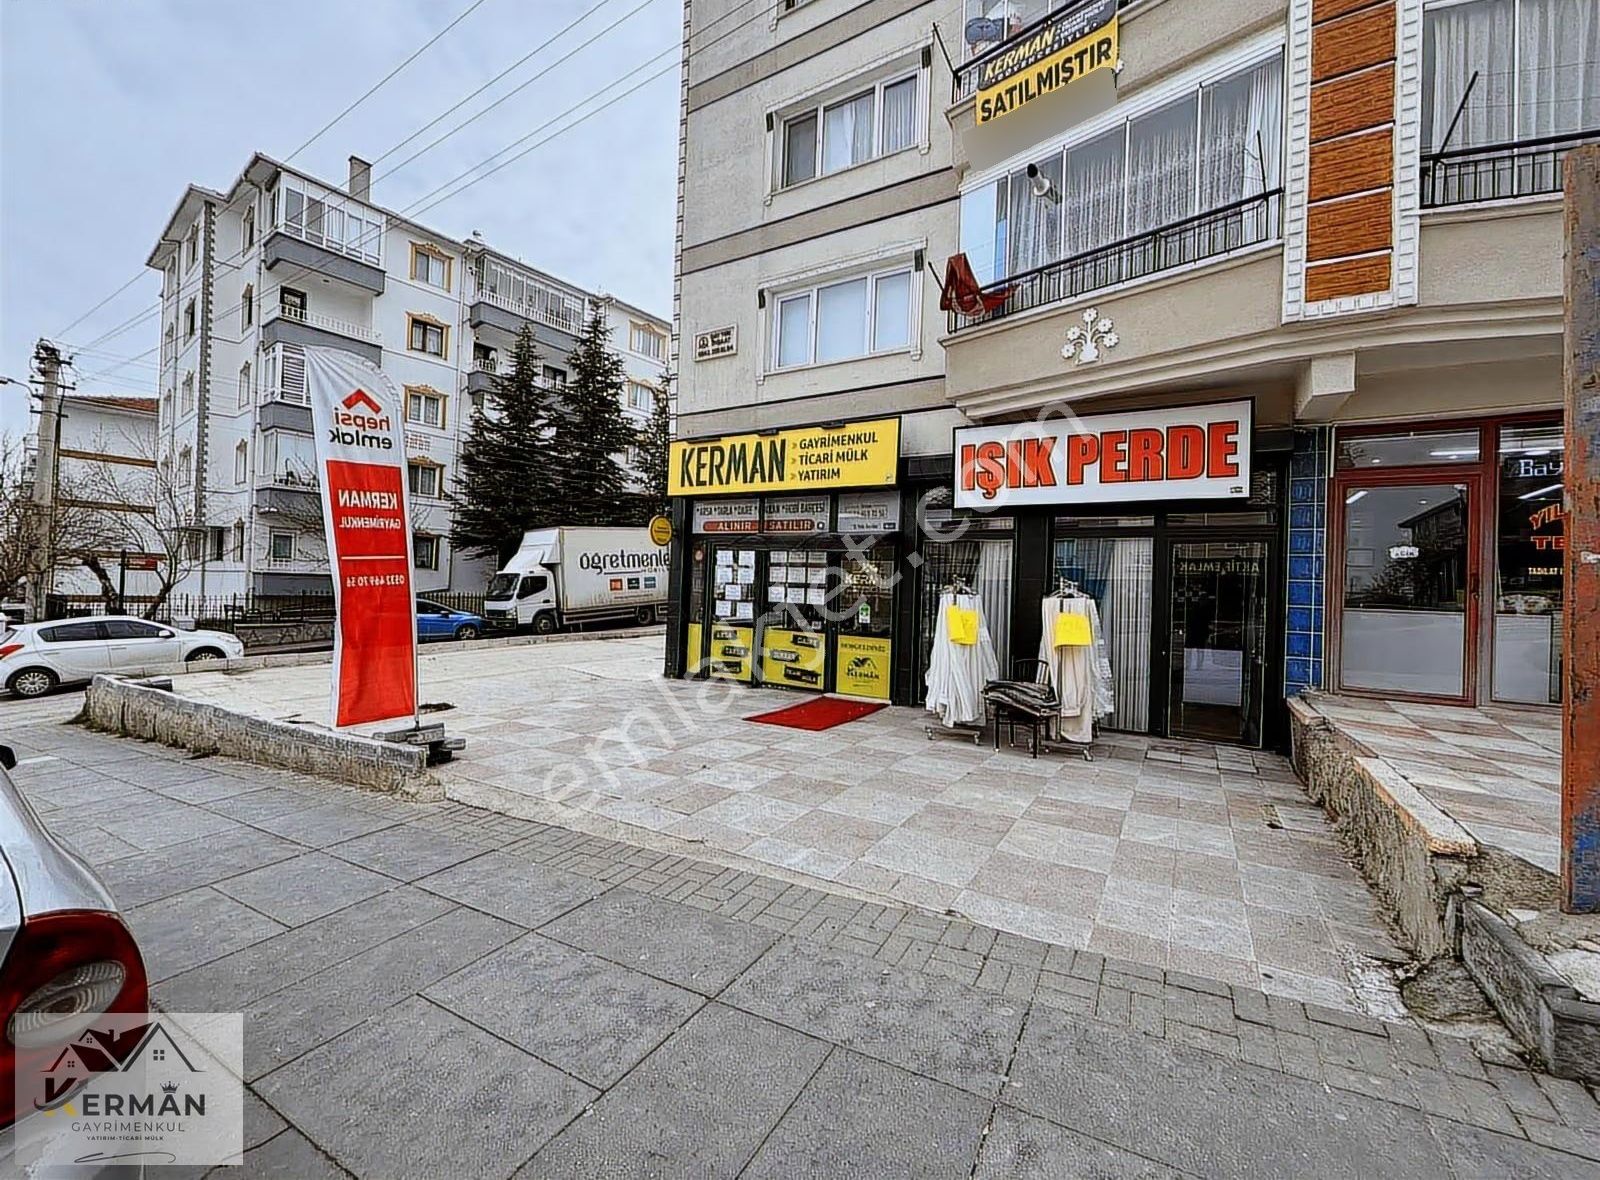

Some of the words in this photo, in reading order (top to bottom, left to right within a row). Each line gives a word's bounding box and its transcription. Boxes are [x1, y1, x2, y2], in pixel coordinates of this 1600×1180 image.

[984, 25, 1056, 82] KERMAN
[980, 37, 1112, 122] SATILMIŞTIR
[799, 431, 878, 450] GAYRİMENKUL
[680, 439, 786, 487] KERMAN
[799, 452, 833, 465] TİCARİ
[836, 448, 868, 462] MÜLK
[960, 436, 1057, 500] IŞIK
[1066, 420, 1240, 486] PERDE
[798, 468, 840, 481] YATIRIM
[717, 521, 751, 531] ALINIR
[769, 520, 811, 530] SATILIR
